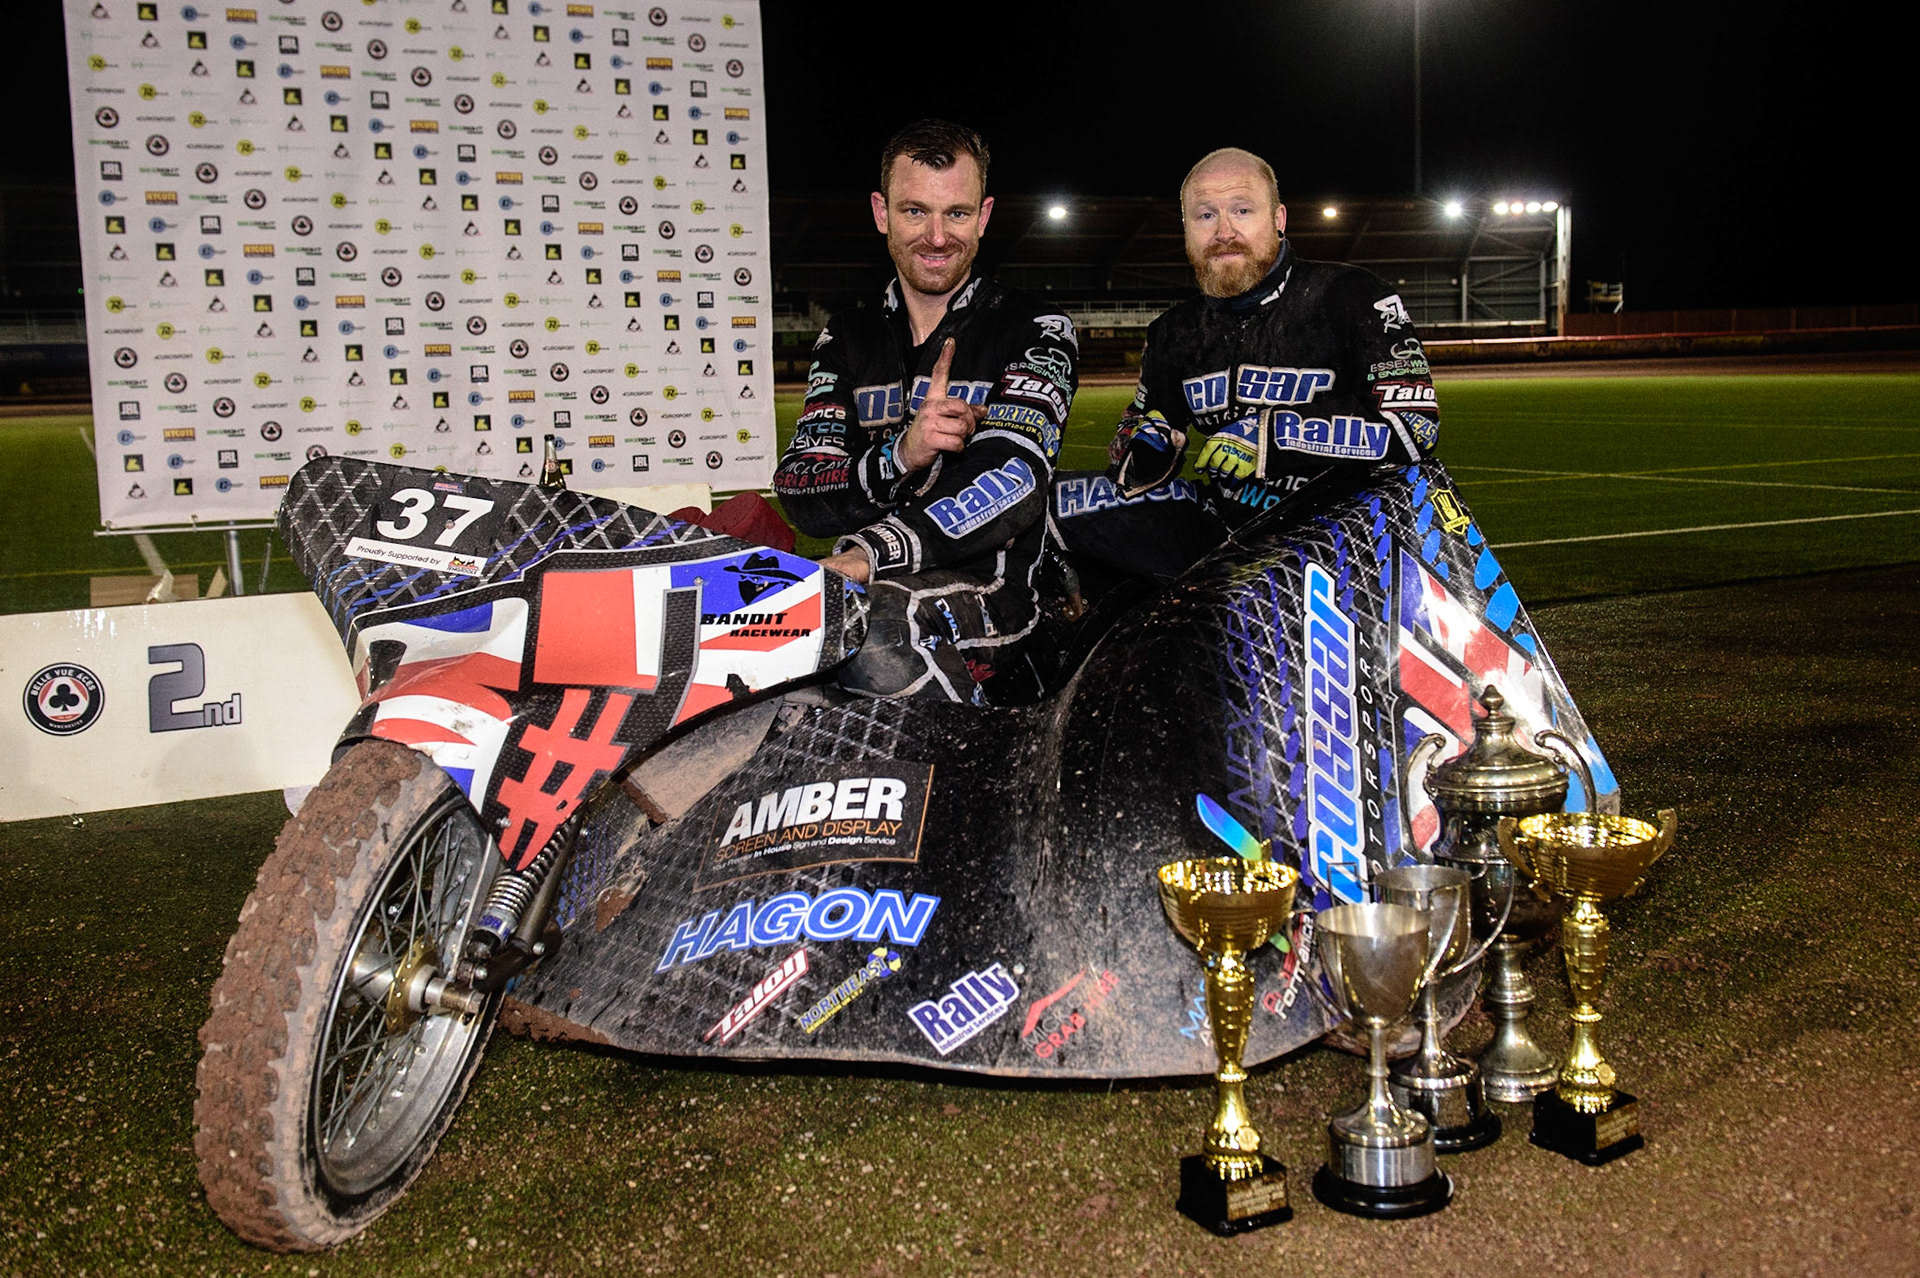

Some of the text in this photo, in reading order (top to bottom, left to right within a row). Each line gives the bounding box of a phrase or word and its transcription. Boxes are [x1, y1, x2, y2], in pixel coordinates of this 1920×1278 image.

[1376, 384, 1436, 400] Talo
[1275, 411, 1389, 457] Rally
[815, 468, 849, 486] HIRE
[928, 457, 1034, 528] Rally
[1056, 476, 1198, 518] HAN
[377, 488, 494, 547] 37
[356, 545, 441, 566] Proudly Supported by
[700, 613, 788, 625] BANDIT
[729, 628, 811, 638] RACEWEAR
[30, 669, 97, 696] BELLE VUE ACES
[148, 643, 242, 733] 2nd
[719, 777, 907, 849] AMBER
[714, 820, 902, 863] SCREEN AND DISPLAY
[754, 849, 763, 859] In
[763, 843, 792, 856] House
[828, 836, 863, 846] Design
[863, 836, 896, 846] Service
[654, 886, 940, 974] HAGON
[704, 948, 809, 1044] Talon
[799, 956, 888, 1030] NORTHEAST
[911, 964, 1017, 1044] Rally
[1035, 1012, 1086, 1058] GRAB
